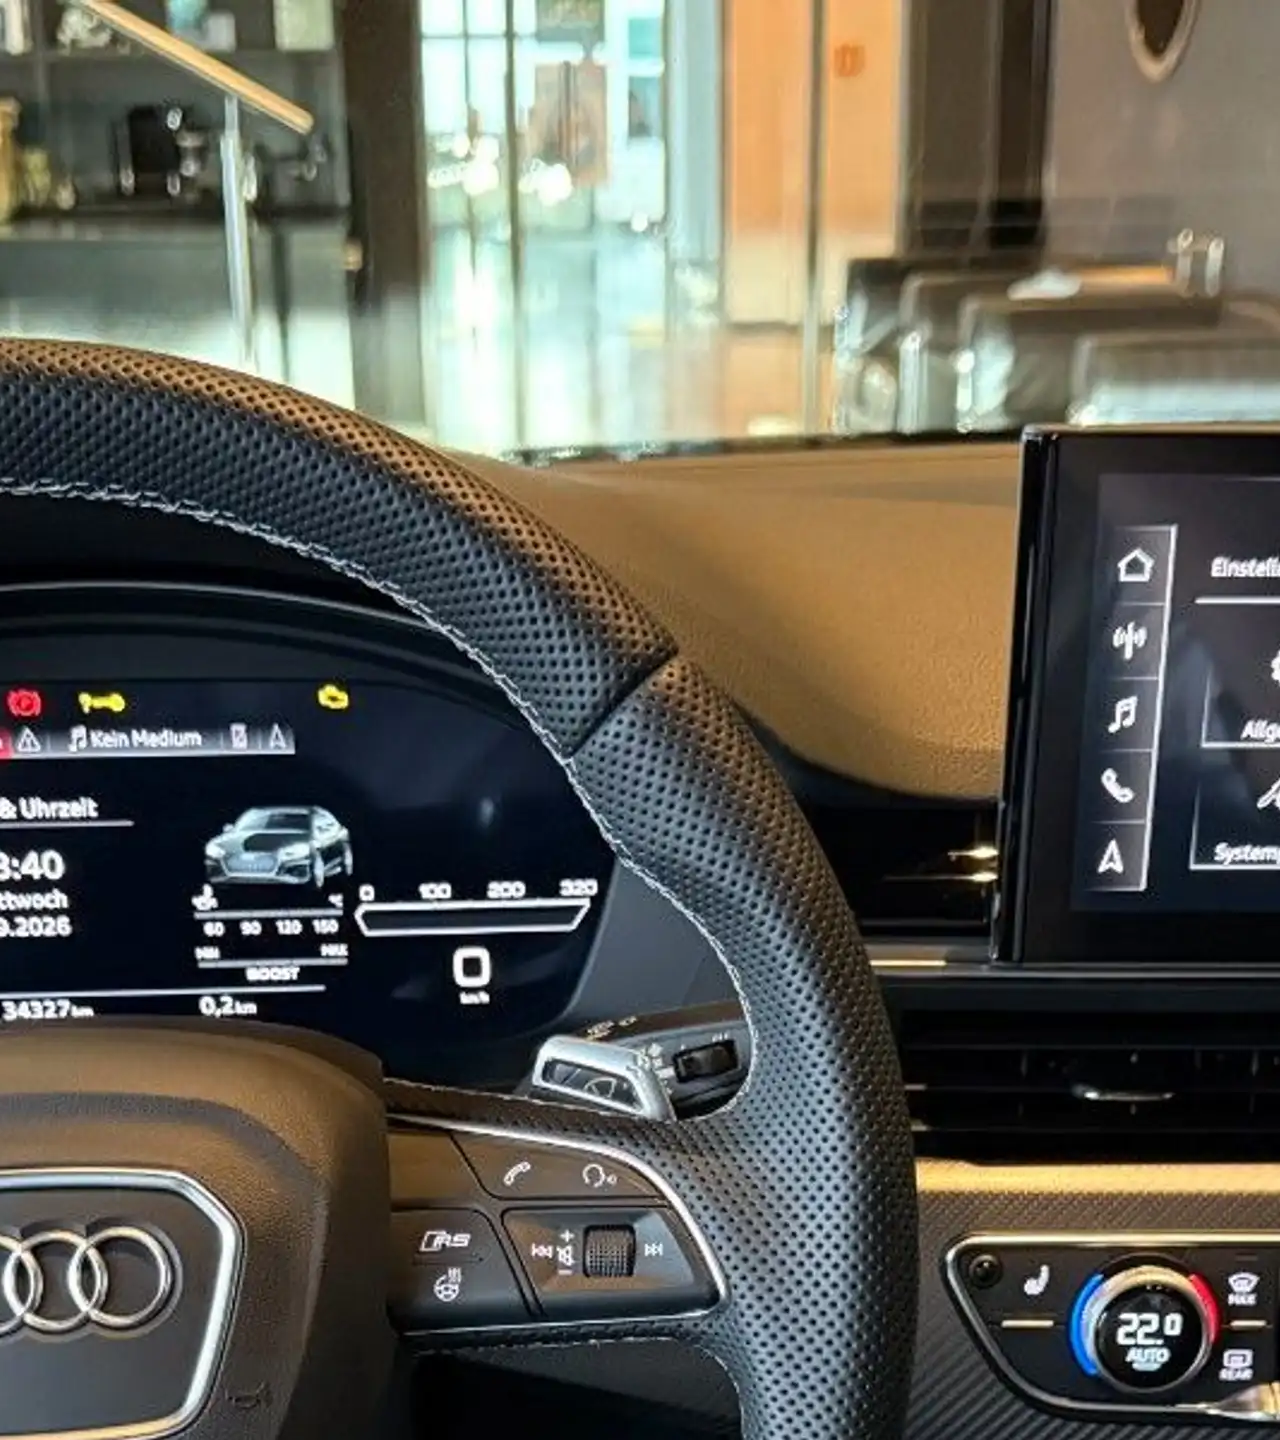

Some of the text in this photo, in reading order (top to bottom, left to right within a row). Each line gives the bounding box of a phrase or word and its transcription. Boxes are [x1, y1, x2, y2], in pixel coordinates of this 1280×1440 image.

[89, 727, 202, 749] Kein Medium
[20, 798, 97, 820] Uhrzeit
[246, 966, 300, 982] BOOST
[453, 946, 491, 987] 0
[2, 999, 69, 1020] 34327
[199, 994, 257, 1017] 0,2 km
[1126, 1347, 1171, 1364] AUTO
